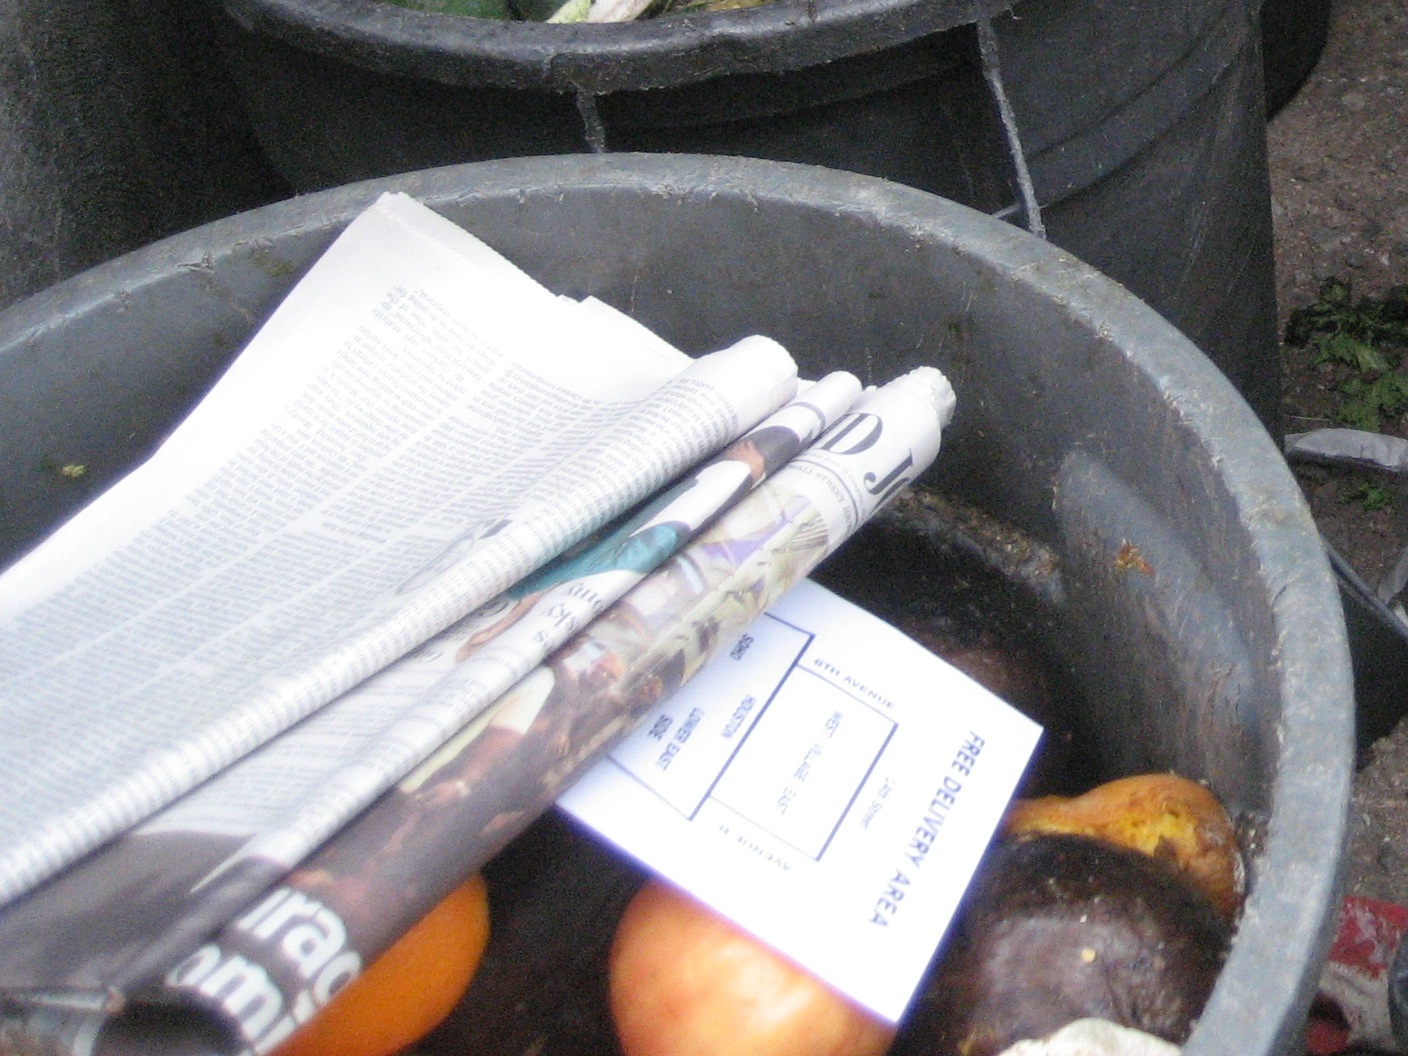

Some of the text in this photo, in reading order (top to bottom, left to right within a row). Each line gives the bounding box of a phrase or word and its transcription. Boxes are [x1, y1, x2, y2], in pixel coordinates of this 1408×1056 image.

[868, 731, 986, 928] FREE DELIVERY AREA
